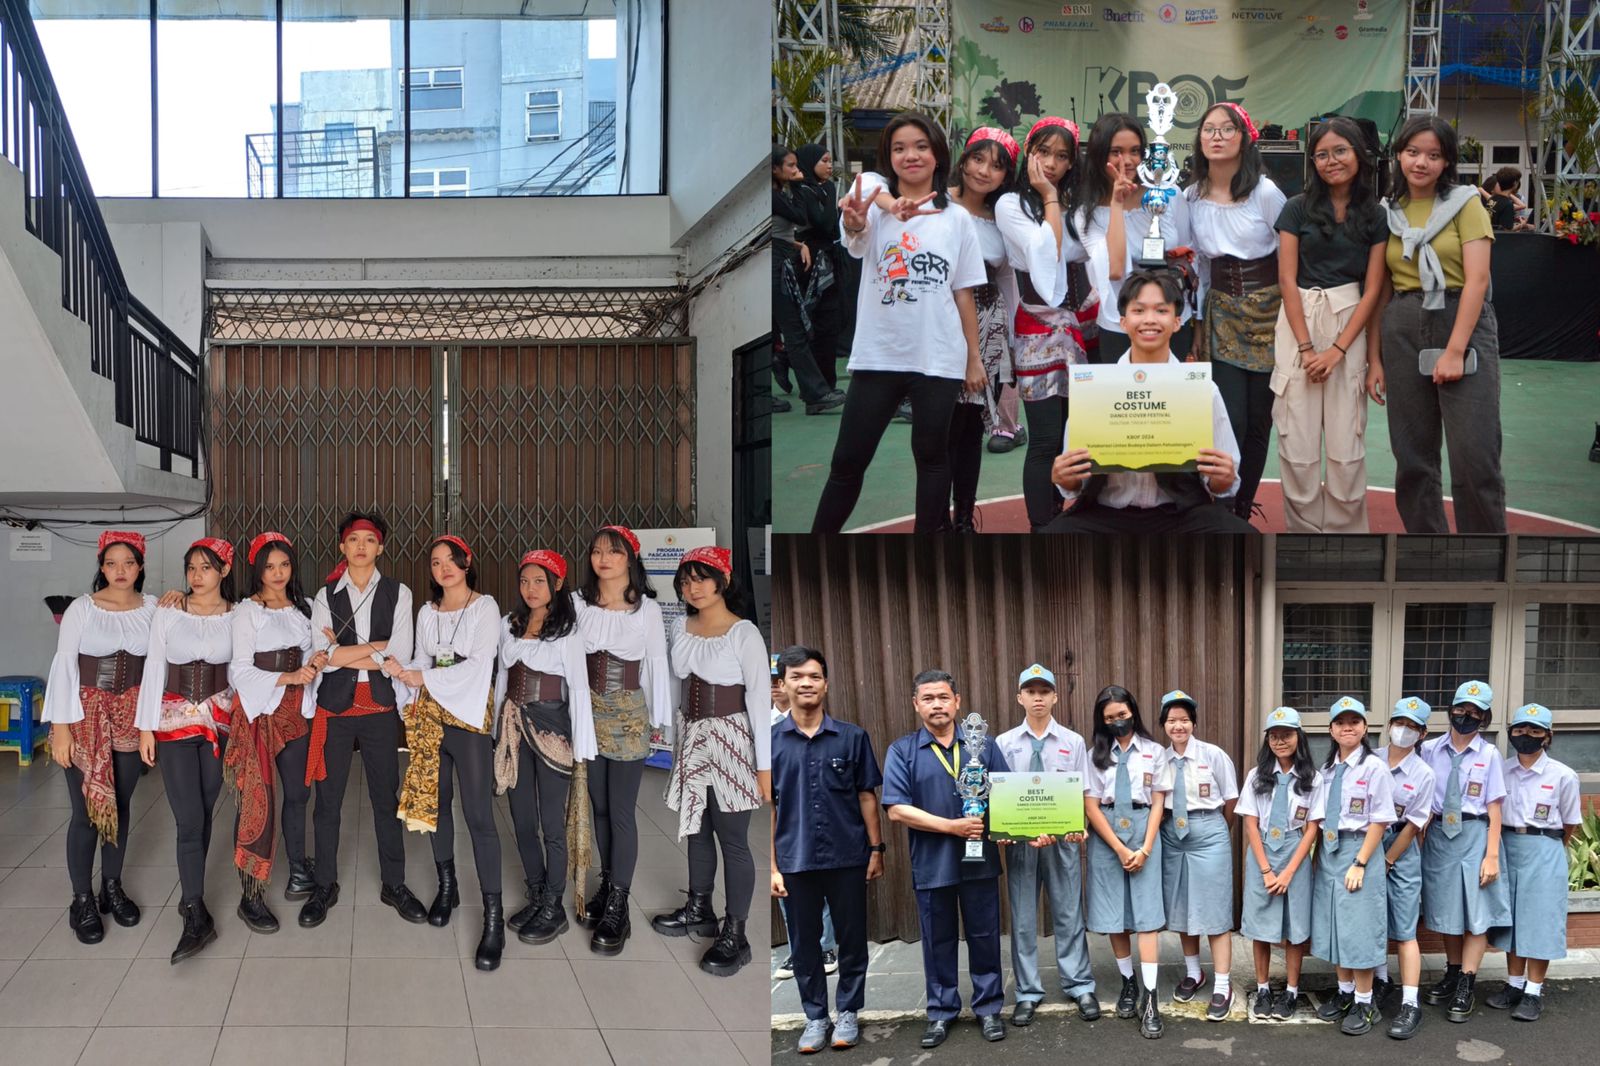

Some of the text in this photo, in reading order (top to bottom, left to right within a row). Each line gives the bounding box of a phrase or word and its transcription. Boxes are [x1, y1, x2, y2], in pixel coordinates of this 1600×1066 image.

[1073, 5, 1091, 14] BNI
[1185, 8, 1216, 16] Kampus
[1185, 14, 1219, 22] Merdeka
[1231, 12, 1283, 20] NETVOLVE
[1126, 391, 1152, 399] BEST
[1114, 401, 1167, 411] COSTUME
